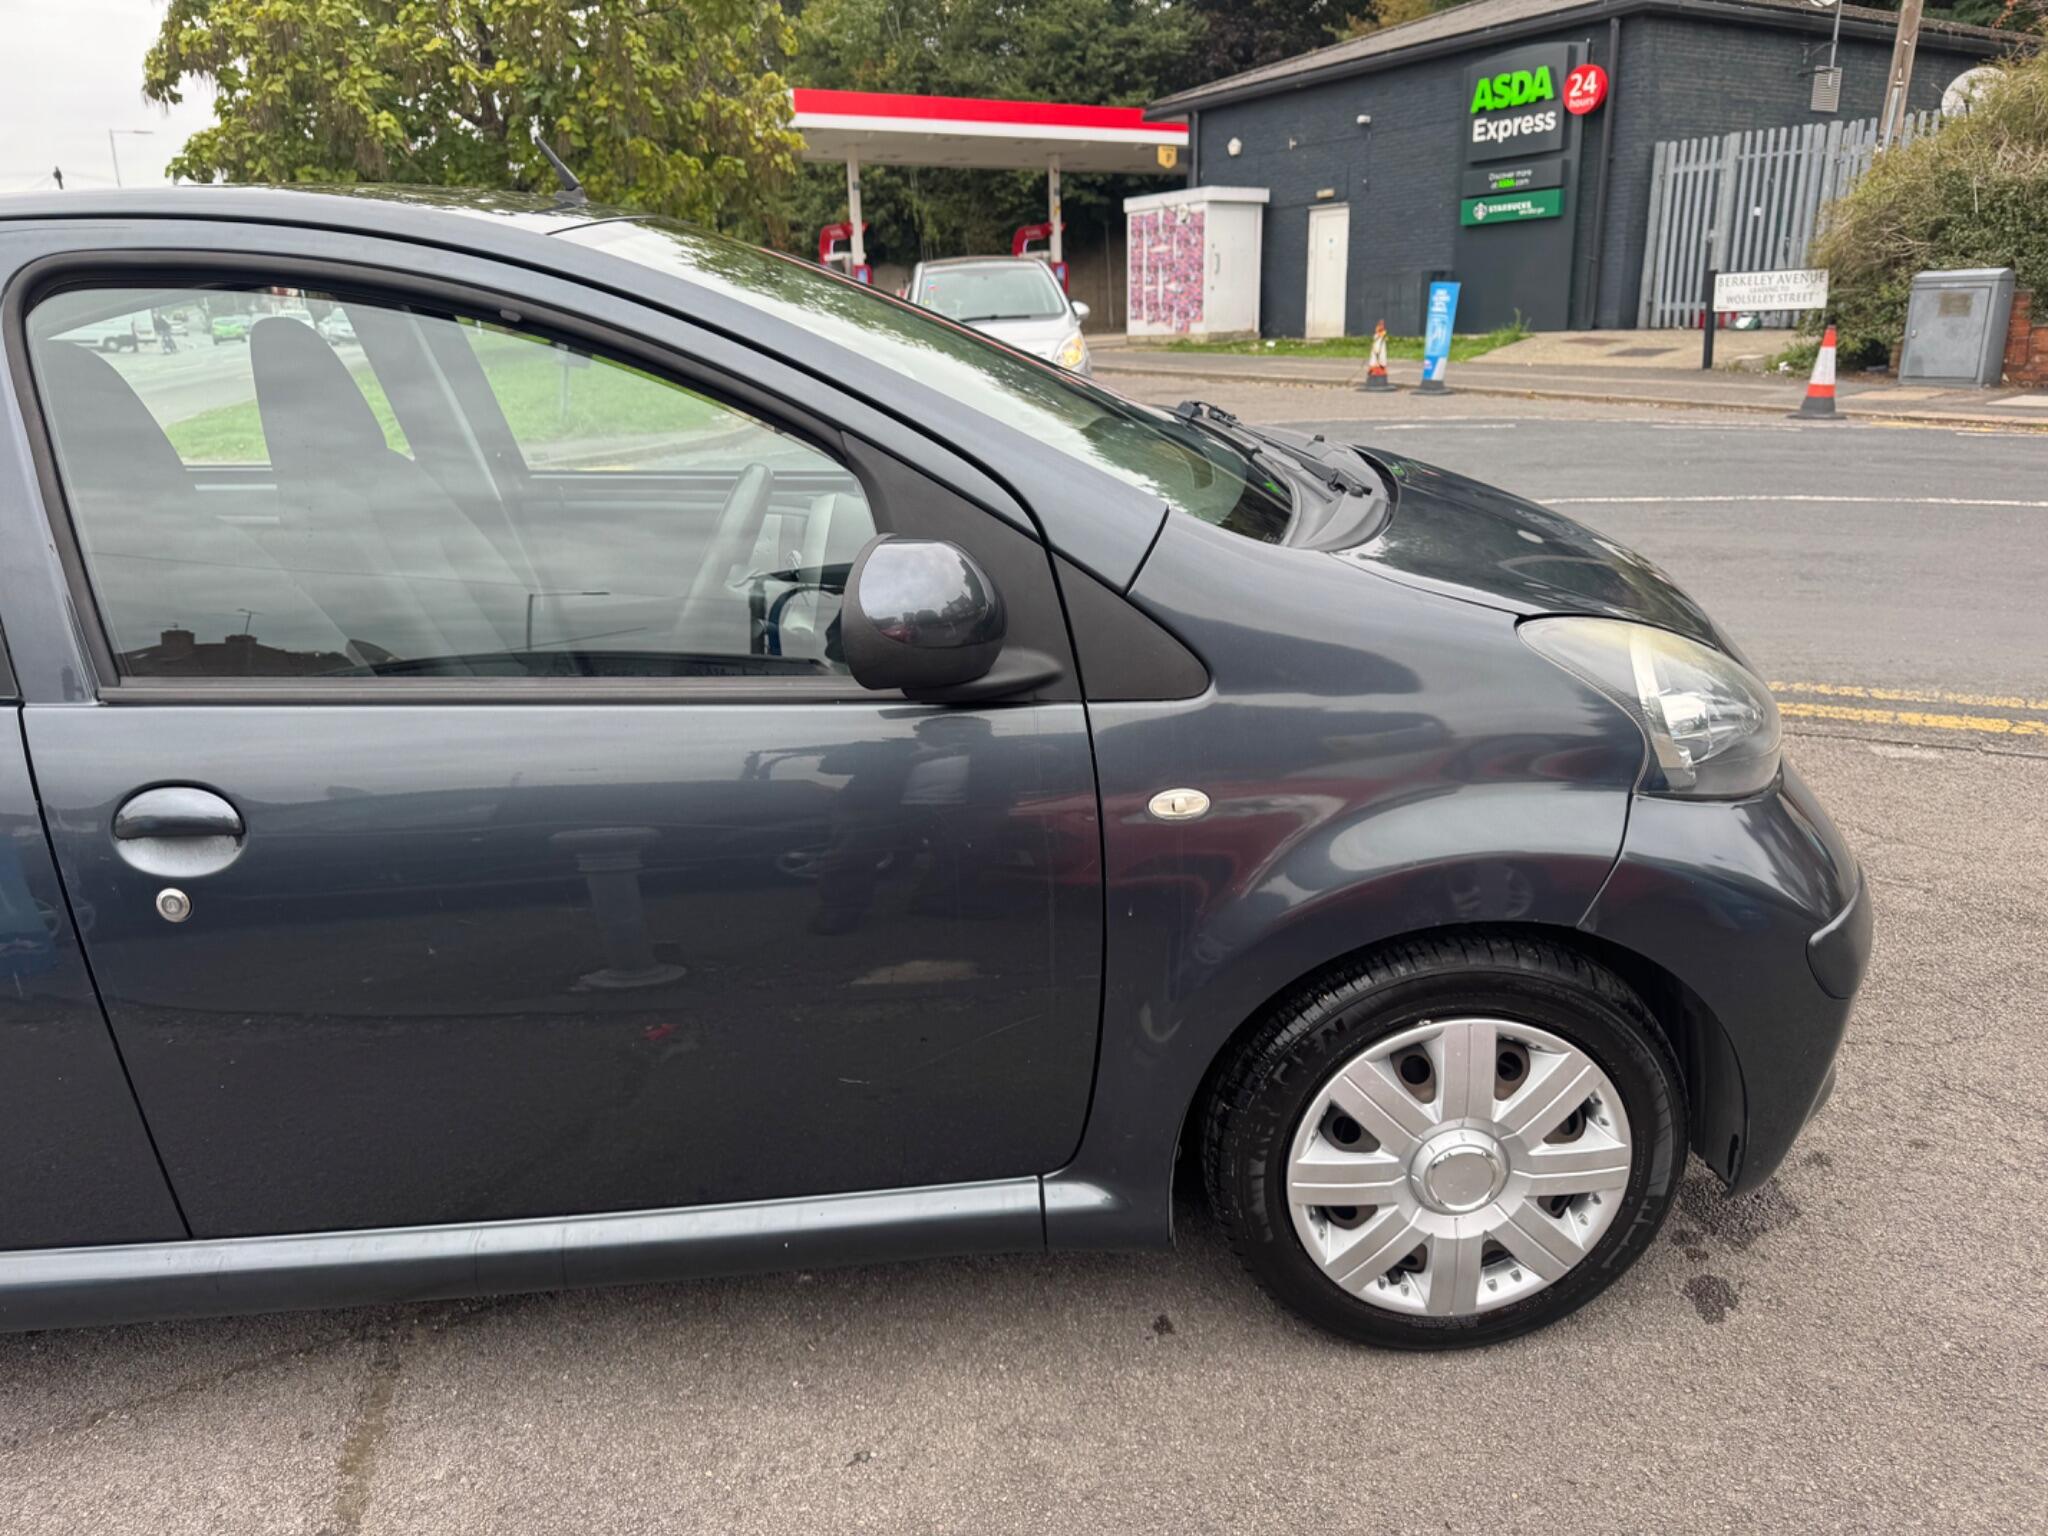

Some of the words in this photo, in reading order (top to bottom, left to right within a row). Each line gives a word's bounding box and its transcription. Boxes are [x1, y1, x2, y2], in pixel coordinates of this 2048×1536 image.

[1470, 65, 1555, 114] ASDA
[1569, 70, 1598, 97] 24
[1569, 97, 1595, 108] hours
[1472, 111, 1557, 143] Express
[1718, 274, 1775, 288] BERKELEY
[1777, 271, 1825, 284] AVENUE
[1726, 294, 1776, 304] WOLSELEY
[1778, 292, 1815, 303] STREET
